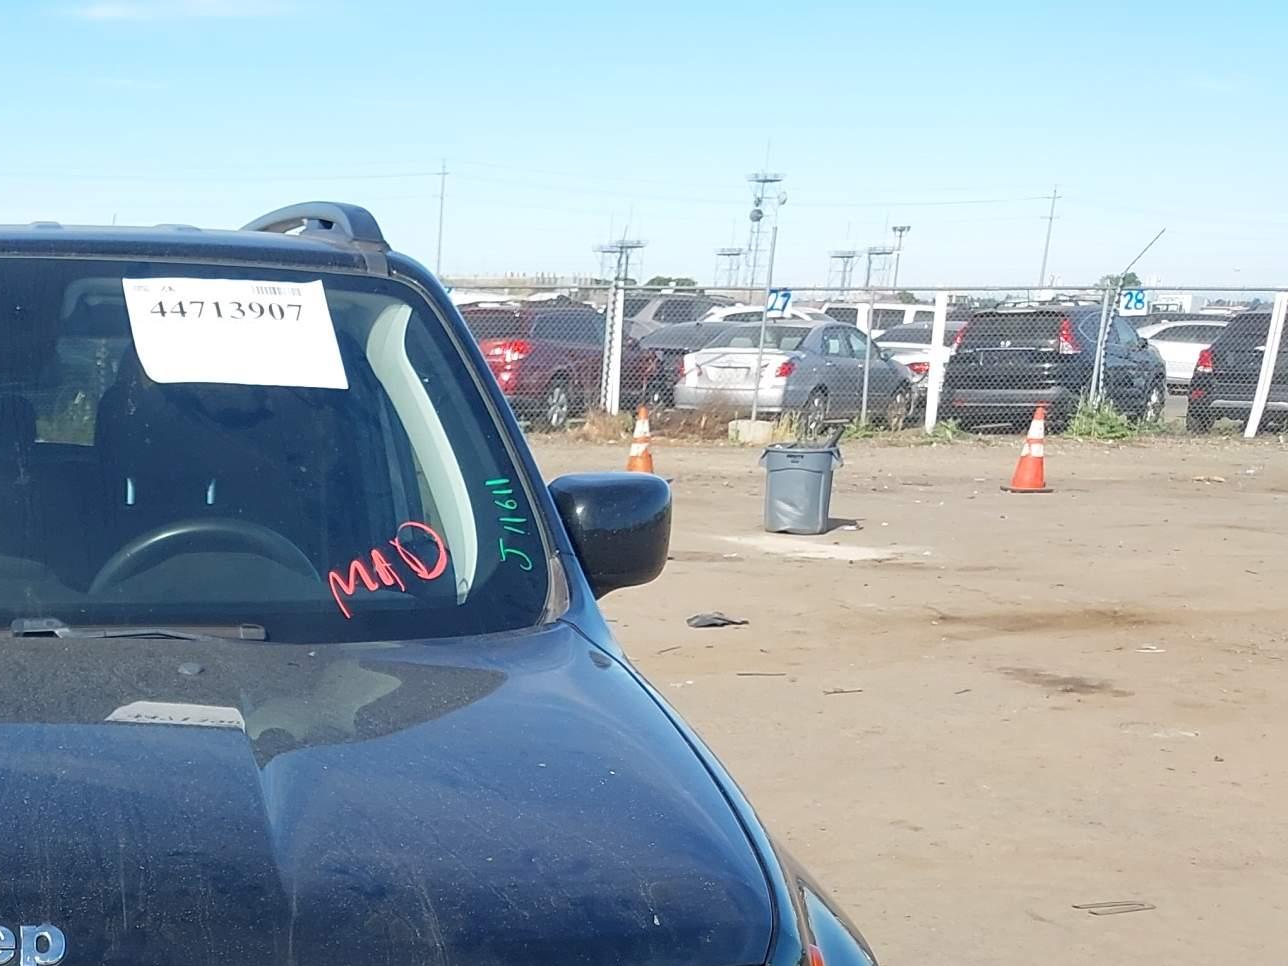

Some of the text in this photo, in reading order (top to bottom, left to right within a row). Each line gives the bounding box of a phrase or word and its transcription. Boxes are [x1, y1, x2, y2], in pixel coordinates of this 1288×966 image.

[149, 300, 303, 321] 44713907
[767, 290, 791, 311] 27
[1123, 291, 1145, 310] 28
